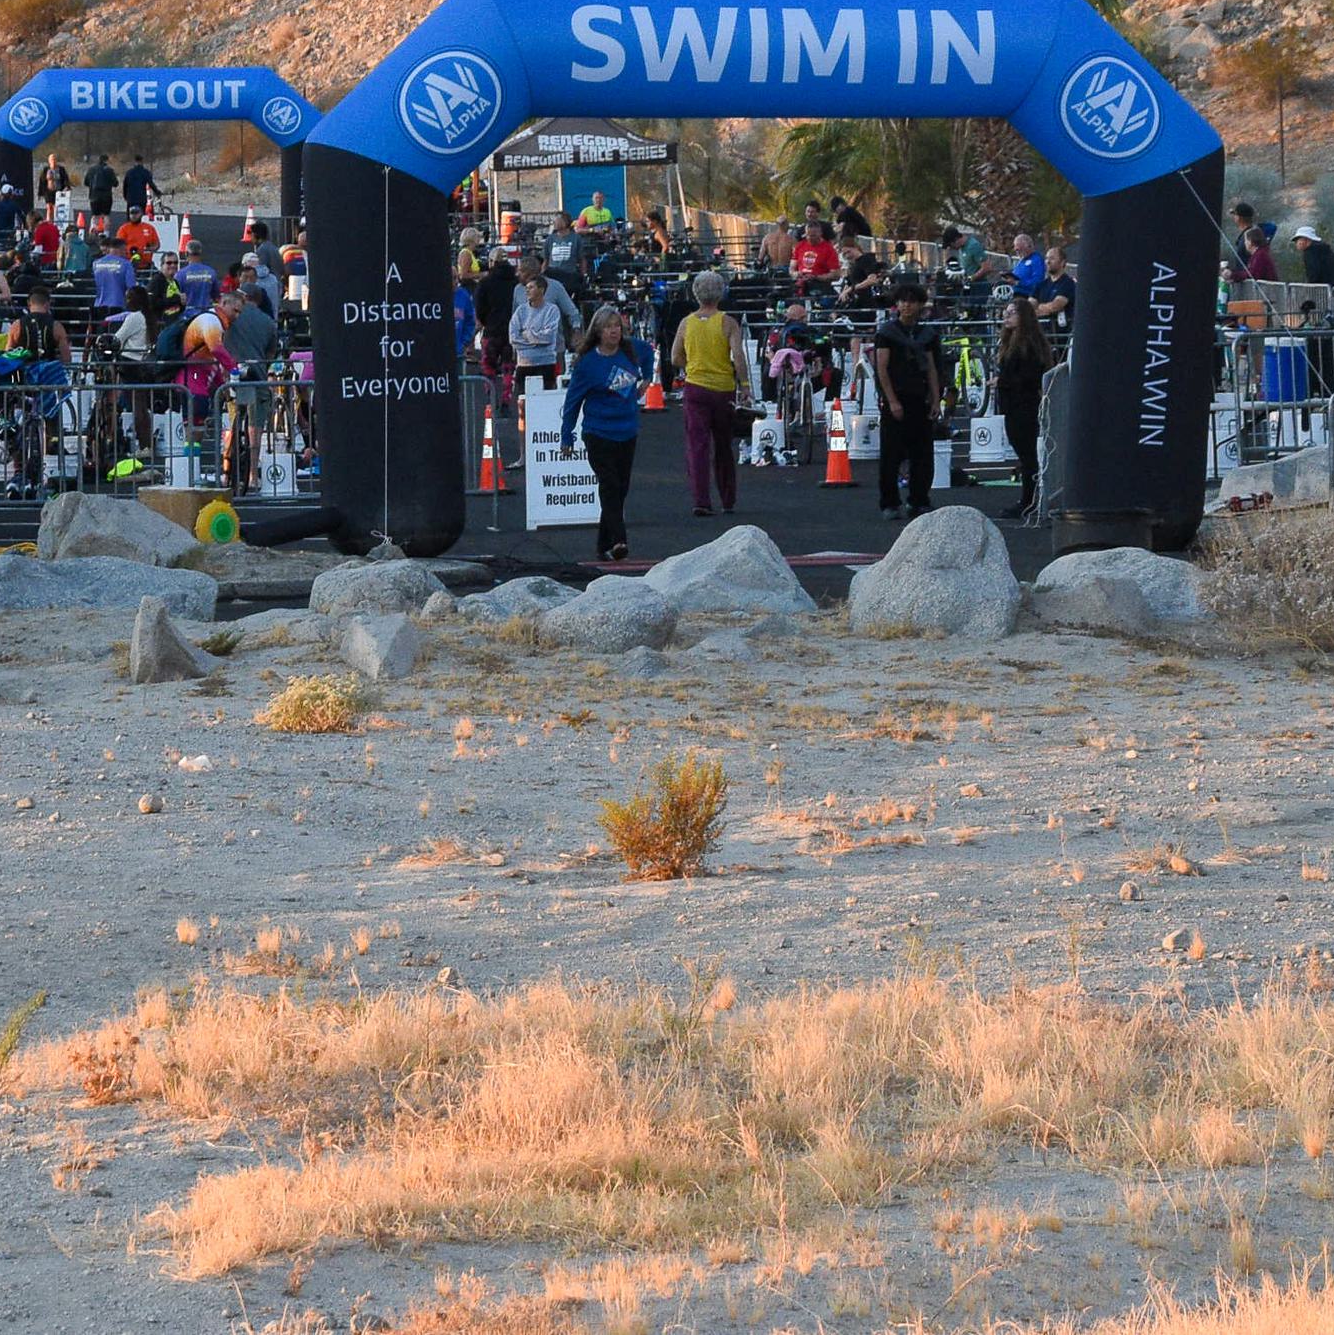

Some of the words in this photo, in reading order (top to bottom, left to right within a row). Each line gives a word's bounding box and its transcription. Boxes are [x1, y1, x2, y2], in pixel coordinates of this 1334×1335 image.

[570, 4, 866, 83] SWIM
[897, 8, 996, 84] IN
[70, 80, 158, 110] BIKE
[165, 79, 246, 110] OUT
[445, 97, 491, 144] ALPHA
[1070, 100, 1118, 148] ALPHA
[619, 144, 668, 161] SERIES
[386, 262, 403, 284] A
[343, 300, 442, 325] Distance
[379, 334, 415, 359] for
[1138, 261, 1178, 446] ALPHA.WIN
[341, 372, 450, 401] Everyone!
[532, 430, 578, 444] Athles
[535, 450, 546, 463] In
[546, 491, 595, 507] Required
